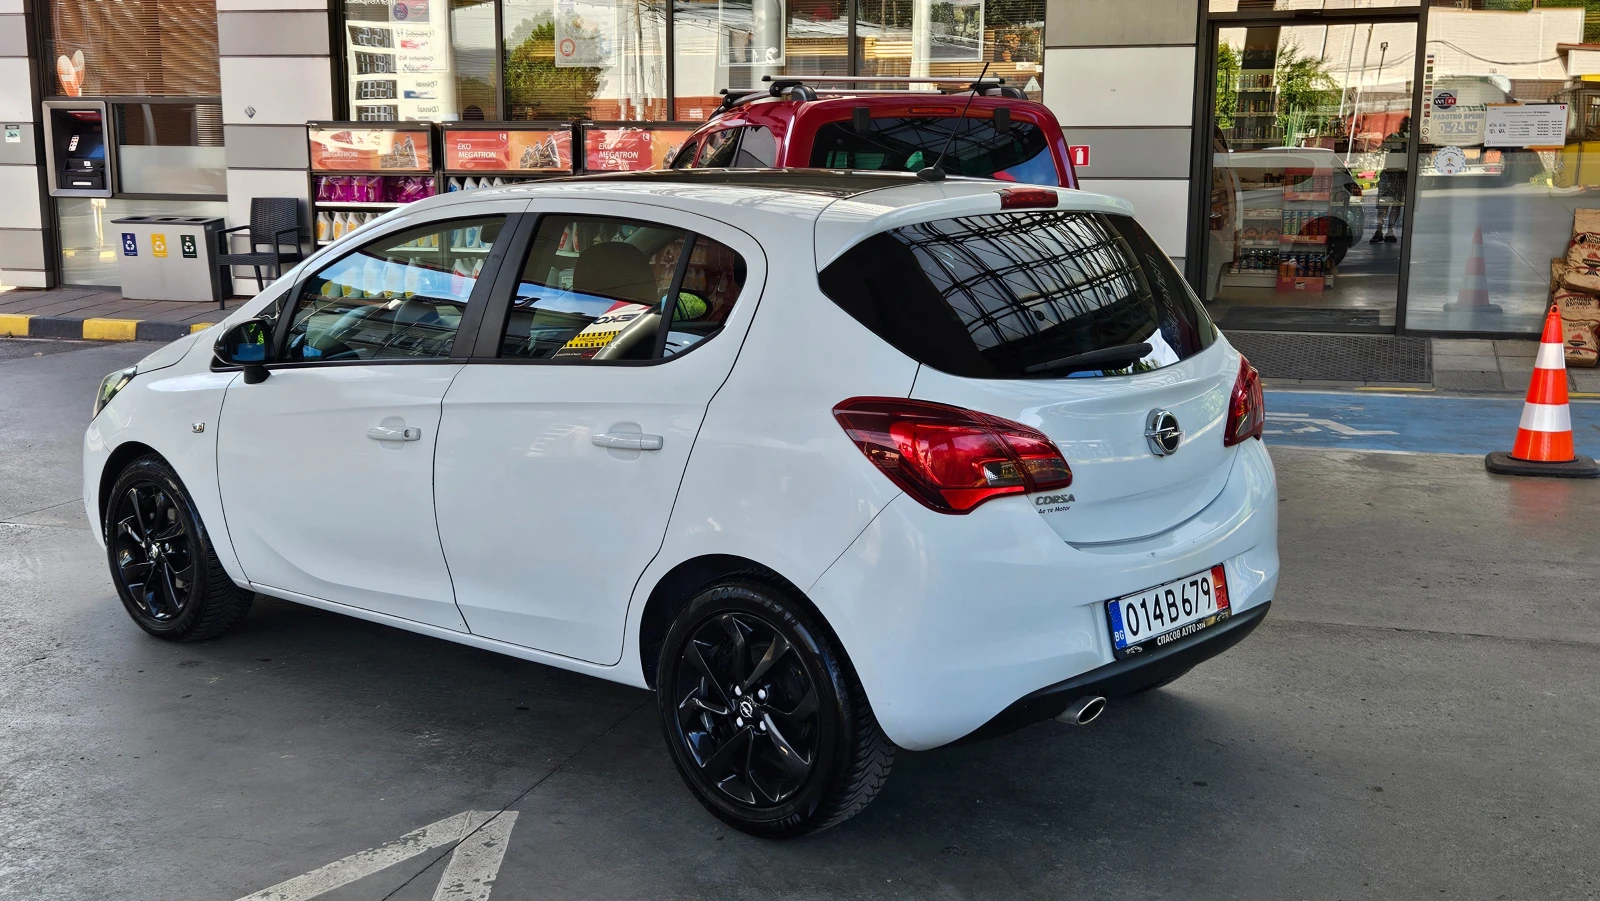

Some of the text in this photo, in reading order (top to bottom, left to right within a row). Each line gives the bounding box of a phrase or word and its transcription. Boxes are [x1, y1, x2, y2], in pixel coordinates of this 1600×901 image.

[457, 142, 472, 150] EKO
[321, 150, 358, 158] MEGATRON
[458, 151, 497, 159] MEGATRON
[598, 151, 639, 159] MEGATRON
[1035, 493, 1076, 506] CORSA
[1114, 629, 1125, 642] BG
[1156, 628, 1182, 646] СПАСОВ
[1181, 623, 1197, 638] АУТО
